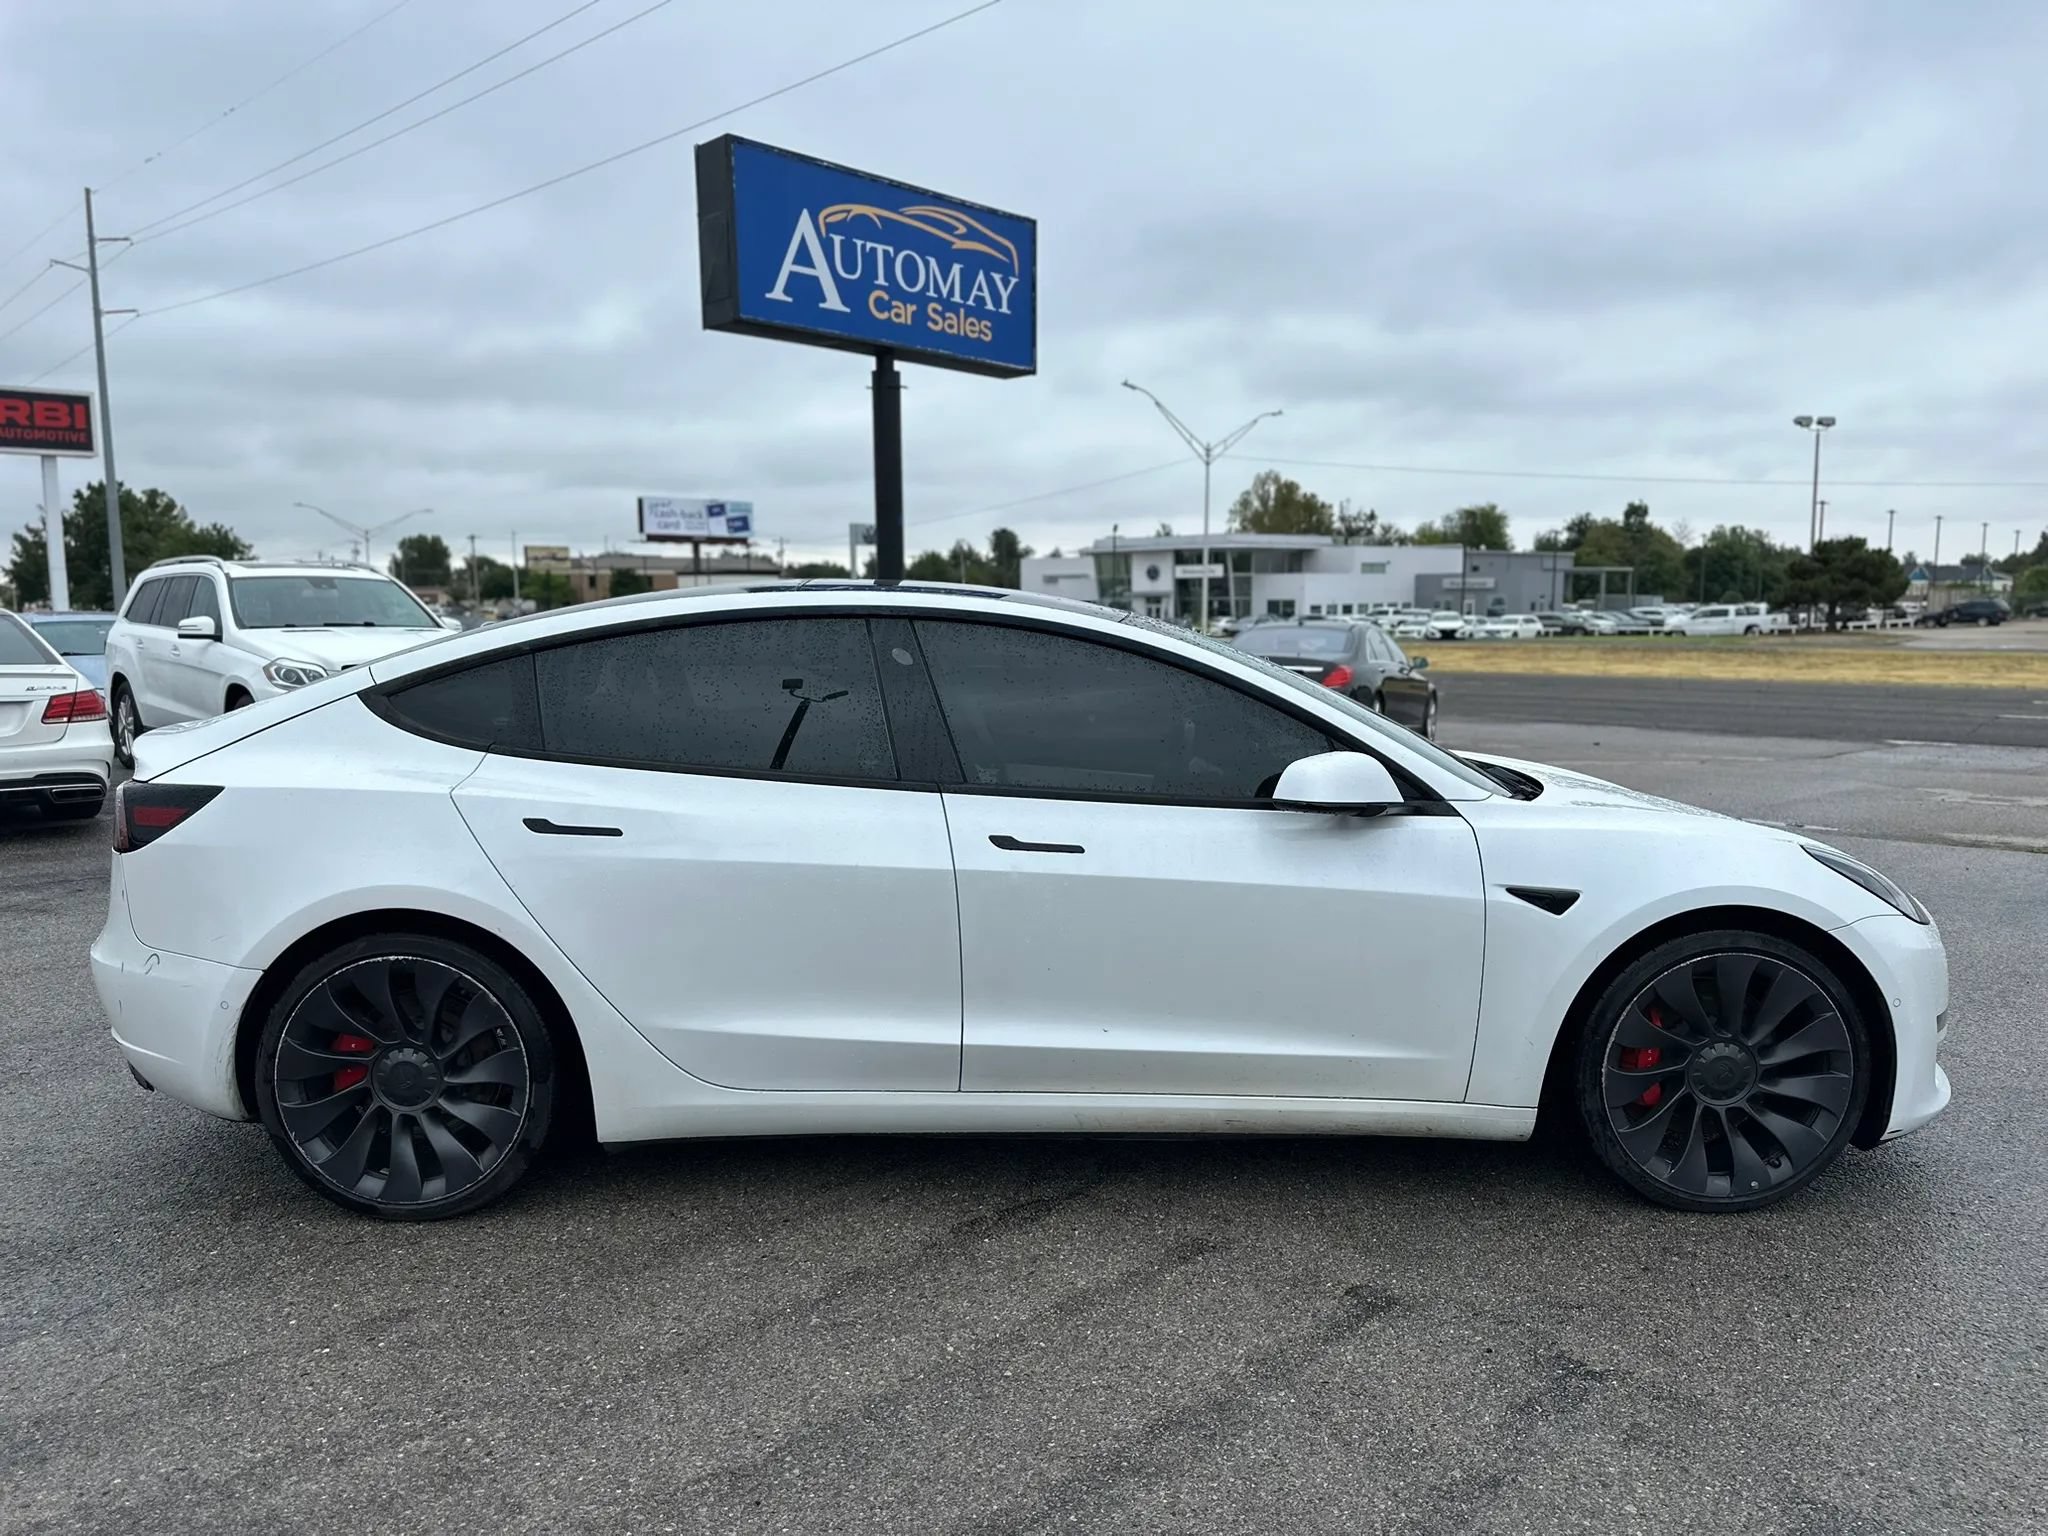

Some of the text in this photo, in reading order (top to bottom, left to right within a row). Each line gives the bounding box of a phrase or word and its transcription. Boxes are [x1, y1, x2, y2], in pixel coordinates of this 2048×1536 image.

[765, 208, 1019, 314] AUTOMAY
[868, 290, 993, 342] Car Sales
[0, 398, 86, 430] RBI
